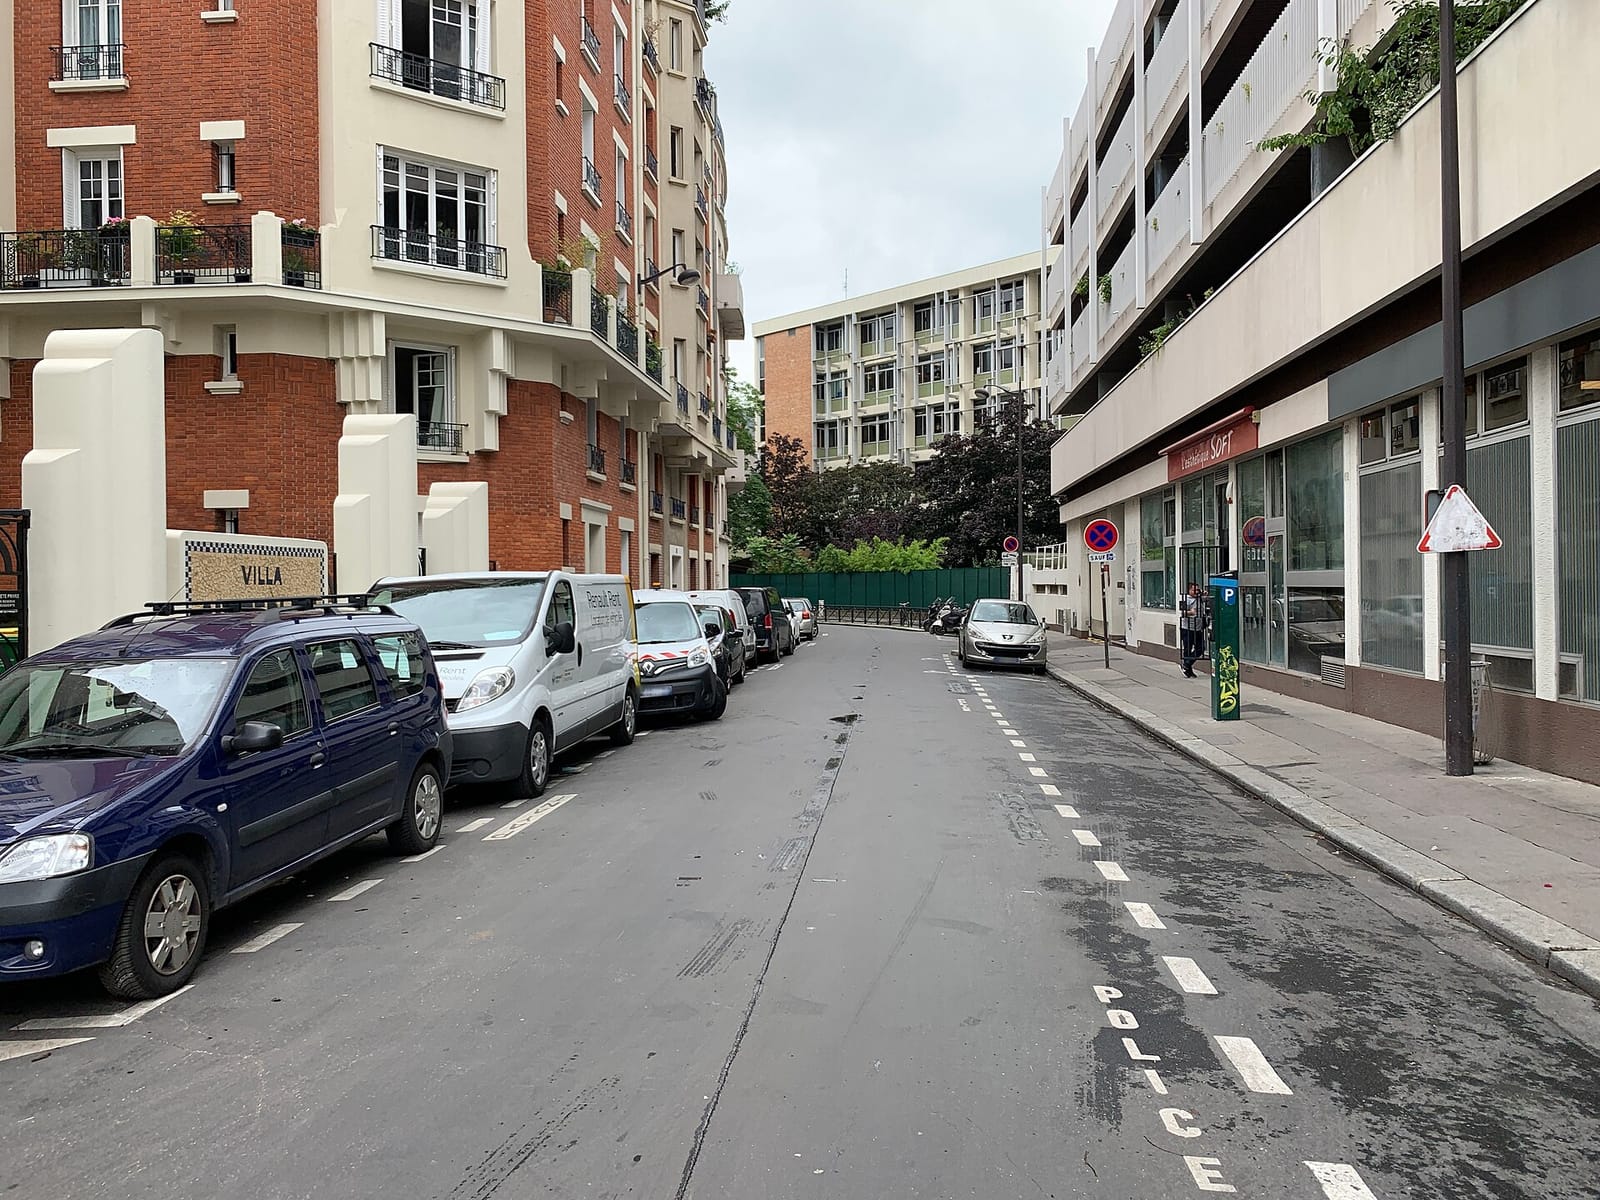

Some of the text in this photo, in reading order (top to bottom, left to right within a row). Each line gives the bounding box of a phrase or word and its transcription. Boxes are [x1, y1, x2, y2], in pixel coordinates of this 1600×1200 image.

[1211, 430, 1233, 459] SOFT
[241, 565, 282, 585] VILLA
[586, 590, 621, 608] Renault Rent
[1224, 588, 1234, 601] P
[1093, 985, 1237, 1193] POLICE
